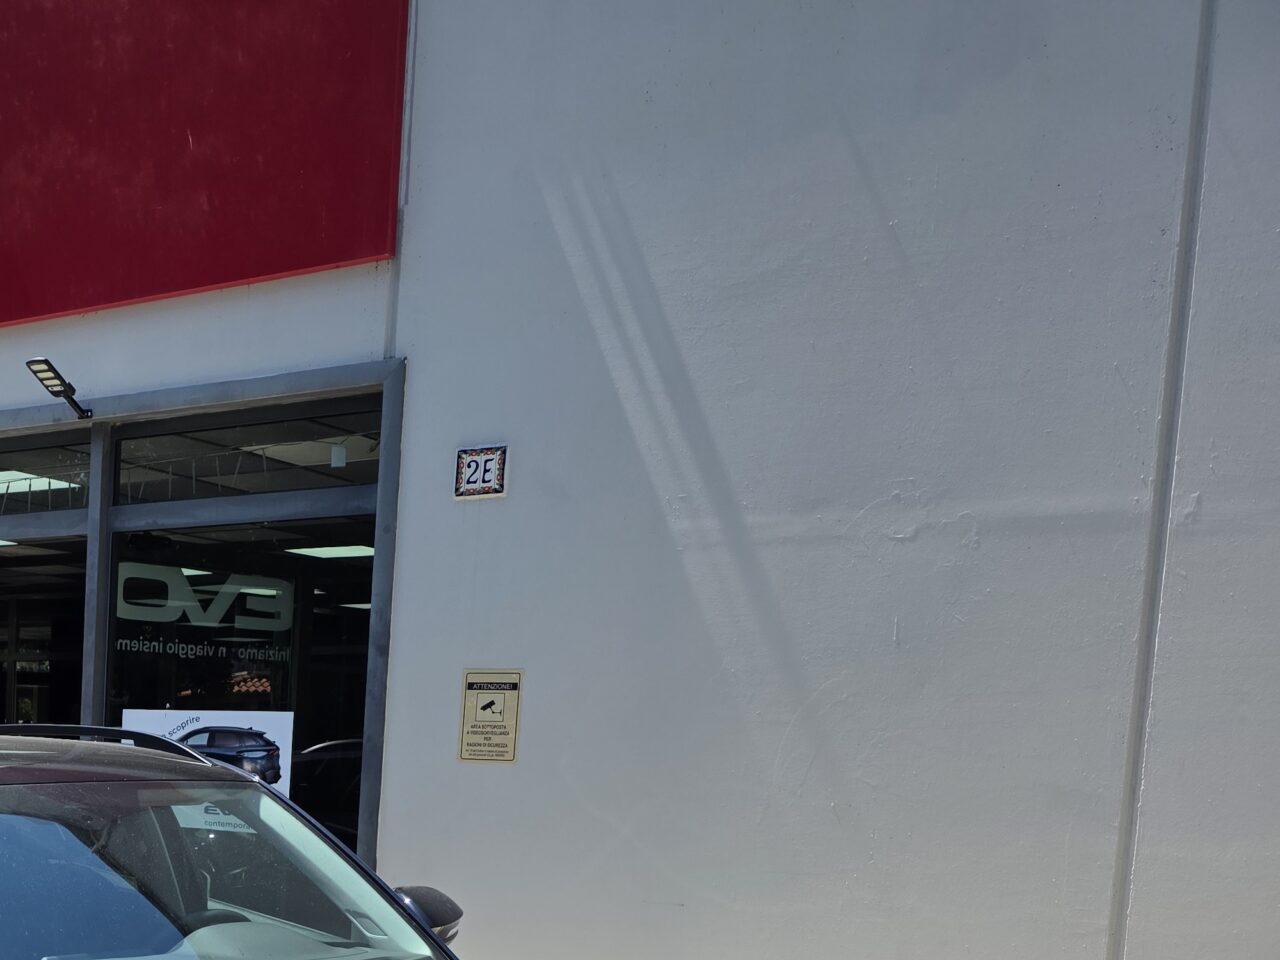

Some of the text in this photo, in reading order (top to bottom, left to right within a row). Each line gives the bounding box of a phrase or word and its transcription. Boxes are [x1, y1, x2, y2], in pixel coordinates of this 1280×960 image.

[466, 457, 495, 485] 2E
[168, 715, 201, 738] scoprire
[203, 819, 252, 831] contempora
